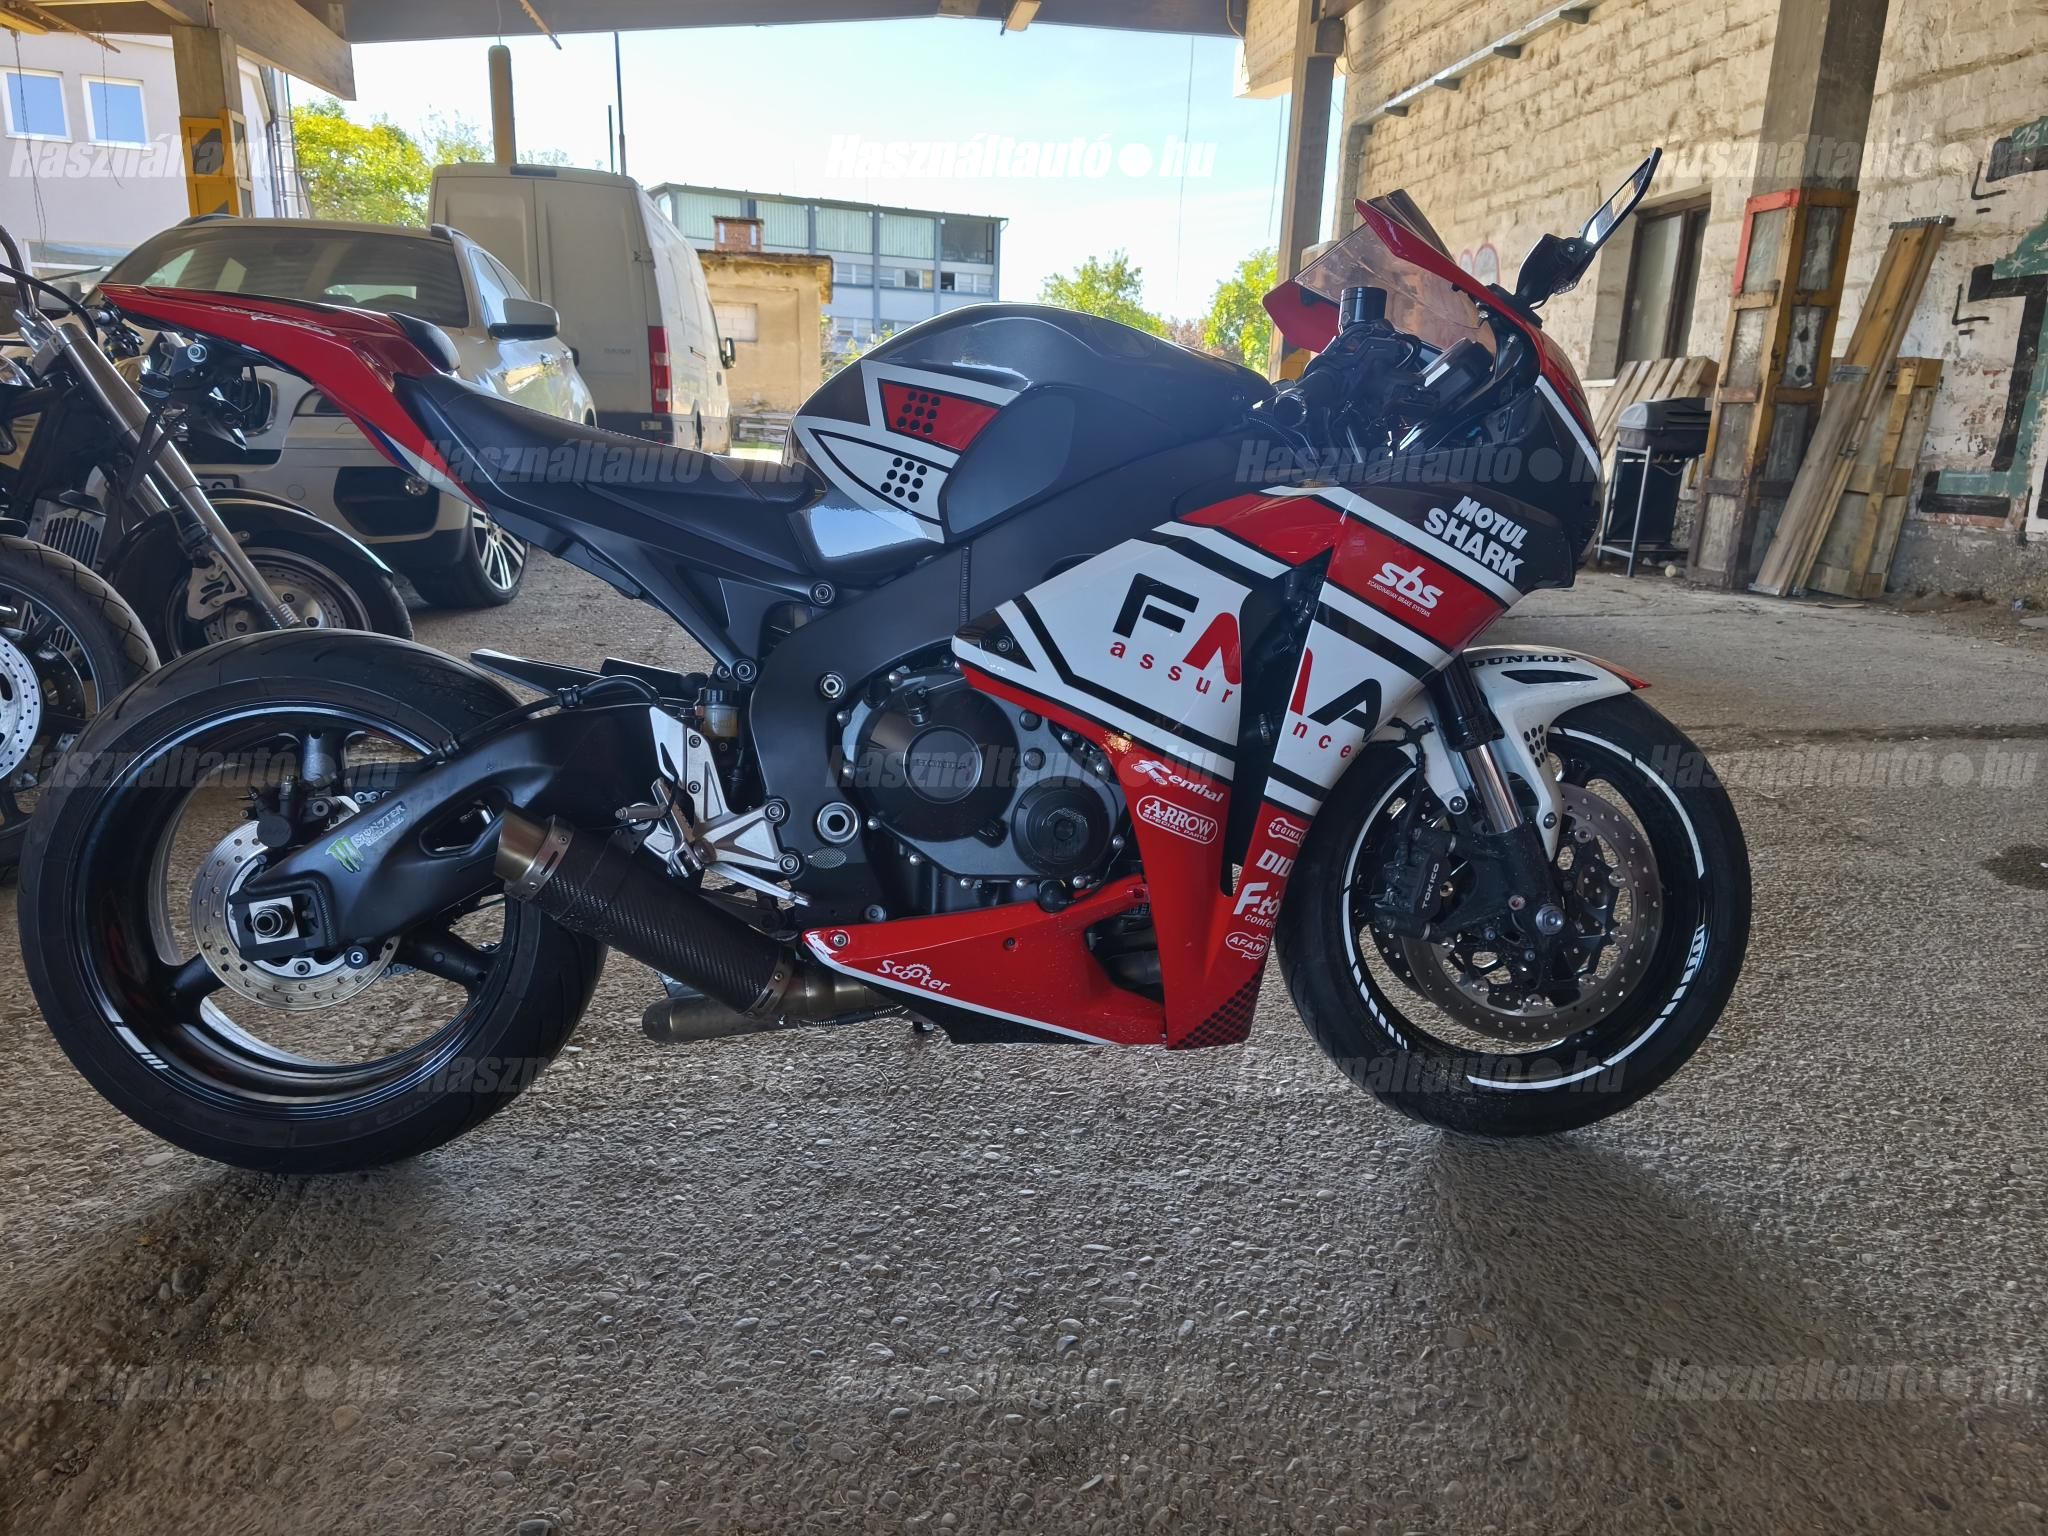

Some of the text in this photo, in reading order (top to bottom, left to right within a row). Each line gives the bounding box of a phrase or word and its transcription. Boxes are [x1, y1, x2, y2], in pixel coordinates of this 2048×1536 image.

[1453, 496, 1528, 549] MOTUL
[1424, 508, 1525, 583] SHARK
[1373, 562, 1445, 609] sbs
[1469, 654, 1577, 668] DUNLOP
[1144, 800, 1214, 837] ARROW
[1269, 821, 1300, 840] REGINA
[1422, 863, 1440, 909] TOKICO
[1229, 936, 1265, 953] AFAM
[877, 959, 951, 991] Scooter
